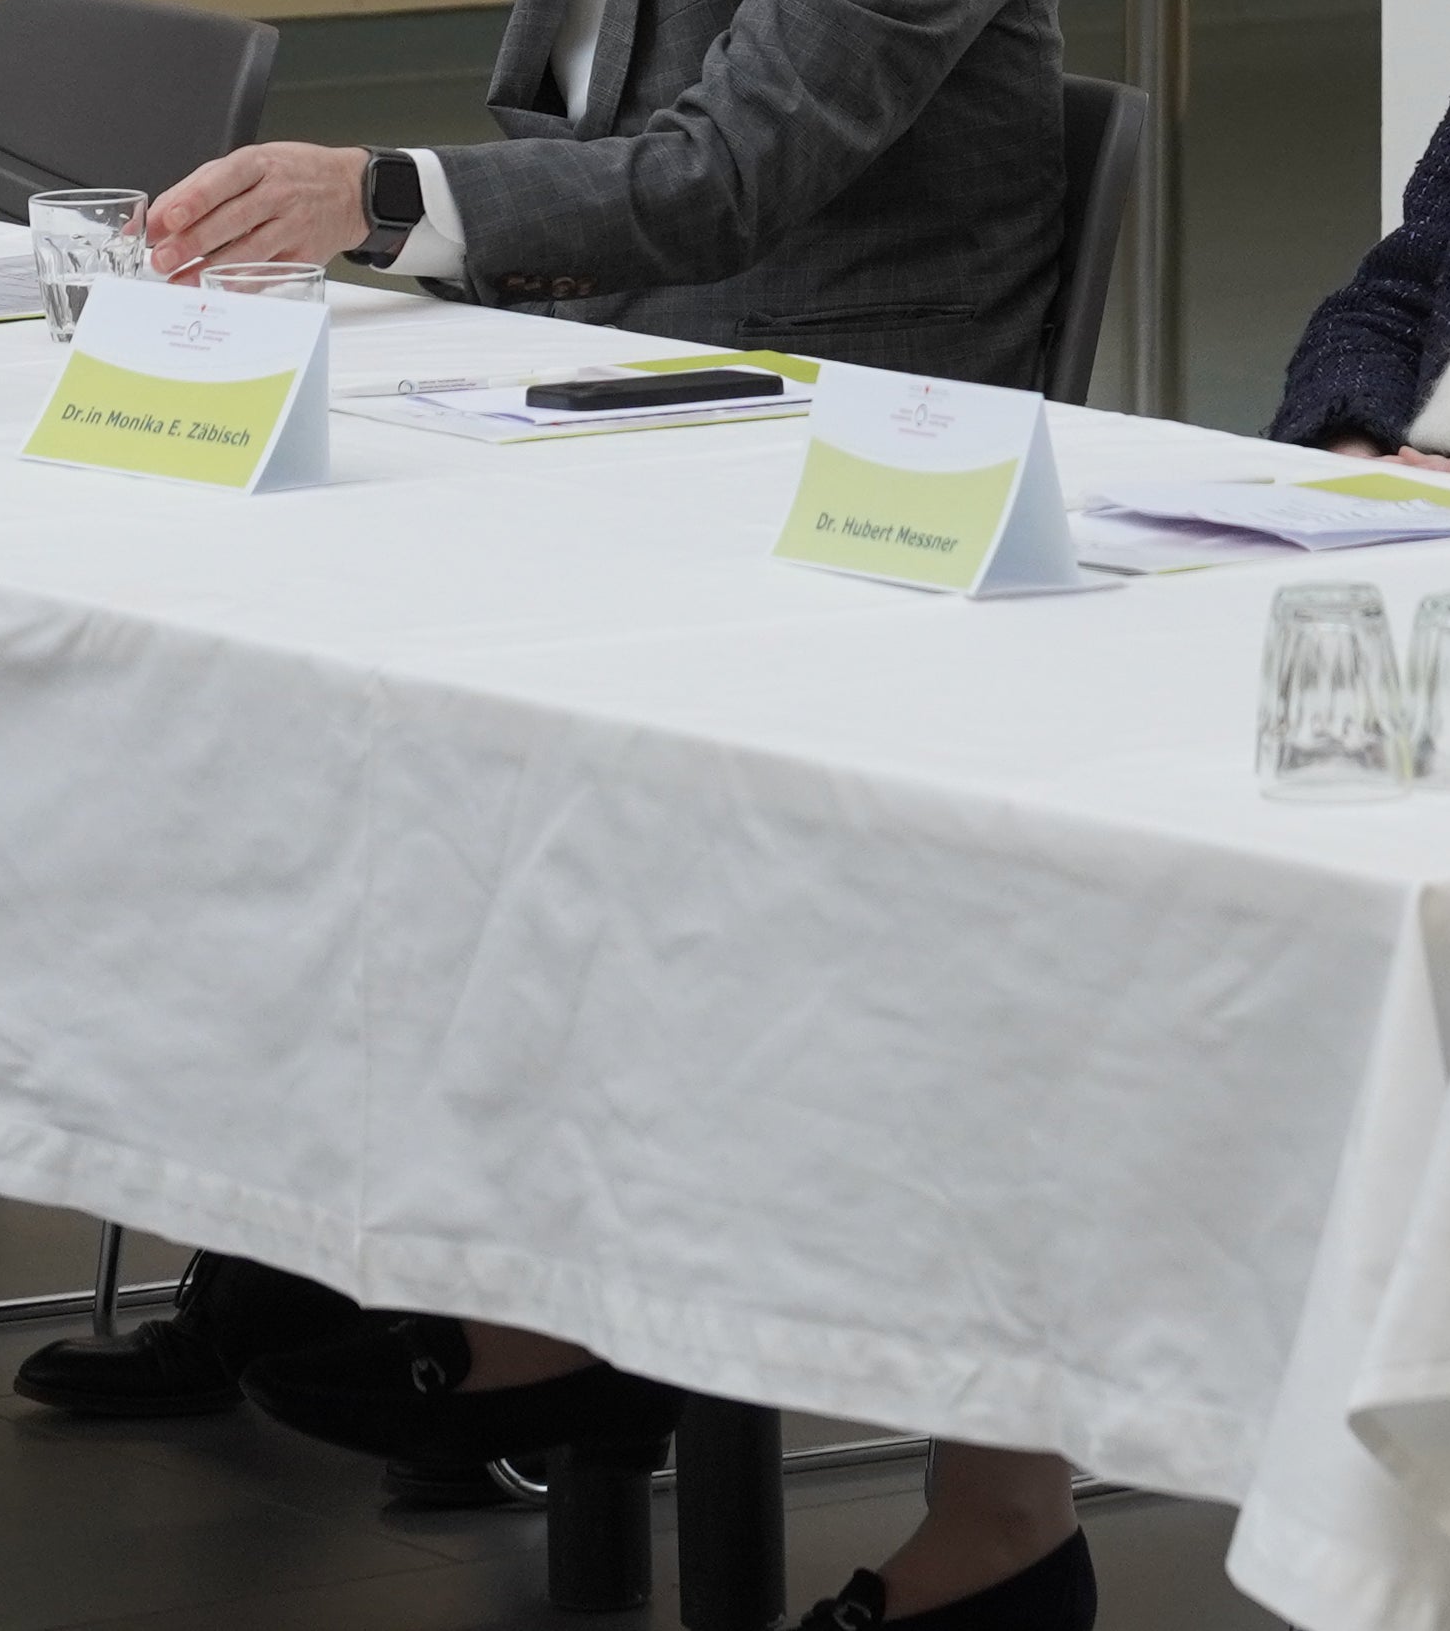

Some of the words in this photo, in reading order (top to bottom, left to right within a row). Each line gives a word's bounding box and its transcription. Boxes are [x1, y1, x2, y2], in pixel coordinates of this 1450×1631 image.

[61, 404, 101, 426] Dr.in
[106, 411, 163, 435] Monika
[168, 420, 181, 437] E.
[187, 422, 250, 448] Zäbisch
[816, 512, 835, 533] Dr.
[842, 517, 893, 542] Hubert
[896, 527, 958, 552] Messner
